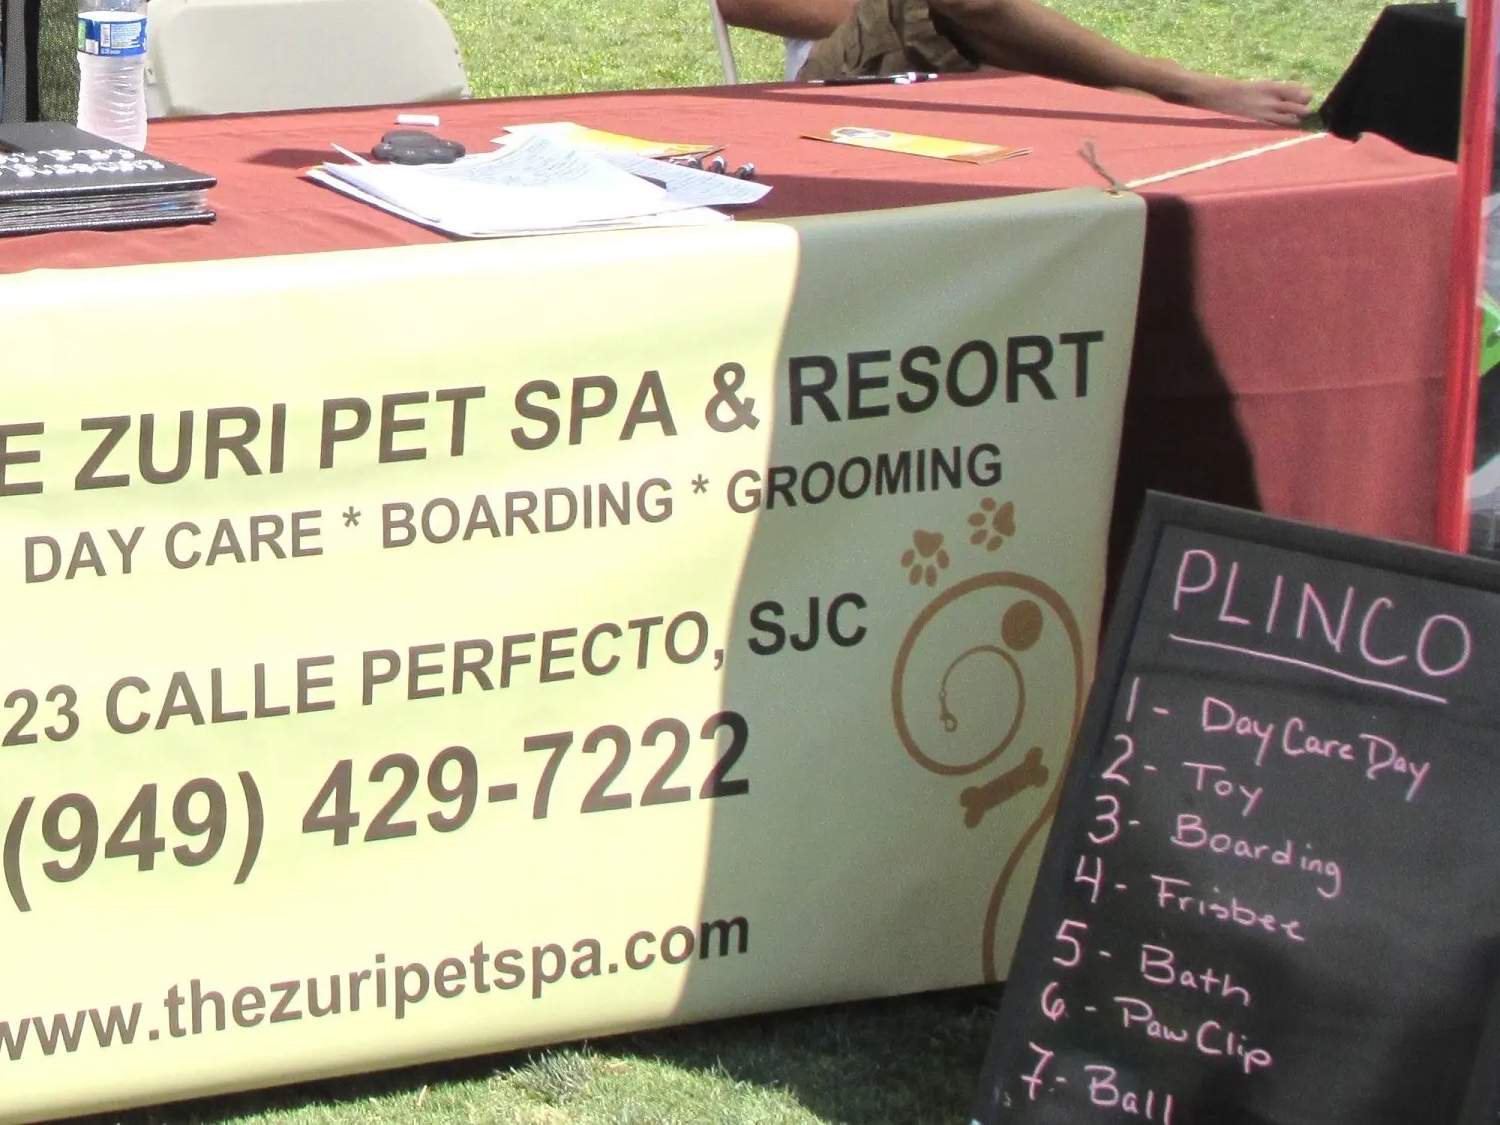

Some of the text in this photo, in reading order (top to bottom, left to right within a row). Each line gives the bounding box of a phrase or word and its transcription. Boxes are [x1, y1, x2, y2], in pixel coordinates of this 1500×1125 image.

[74, 402, 287, 491] ZURI
[319, 385, 487, 470] PET
[509, 369, 678, 452] SPA
[704, 361, 762, 434] &
[788, 330, 1105, 426] RESORT
[24, 442, 1002, 584] DAY CARE BOARDING GROOMING
[1172, 549, 1470, 676] PLINCO
[105, 654, 336, 736] CALLE
[361, 610, 726, 708] PERFECTO,
[746, 591, 869, 657] SJC
[2, 710, 751, 912] (949) 429-7222
[1182, 761, 1263, 817] Toy
[1171, 814, 1341, 899] Boarding
[1151, 874, 1306, 942] Frisbee
[1141, 944, 1251, 1006] Bath
[1114, 997, 1187, 1043] Paw
[1084, 1064, 1174, 1125] Ball
